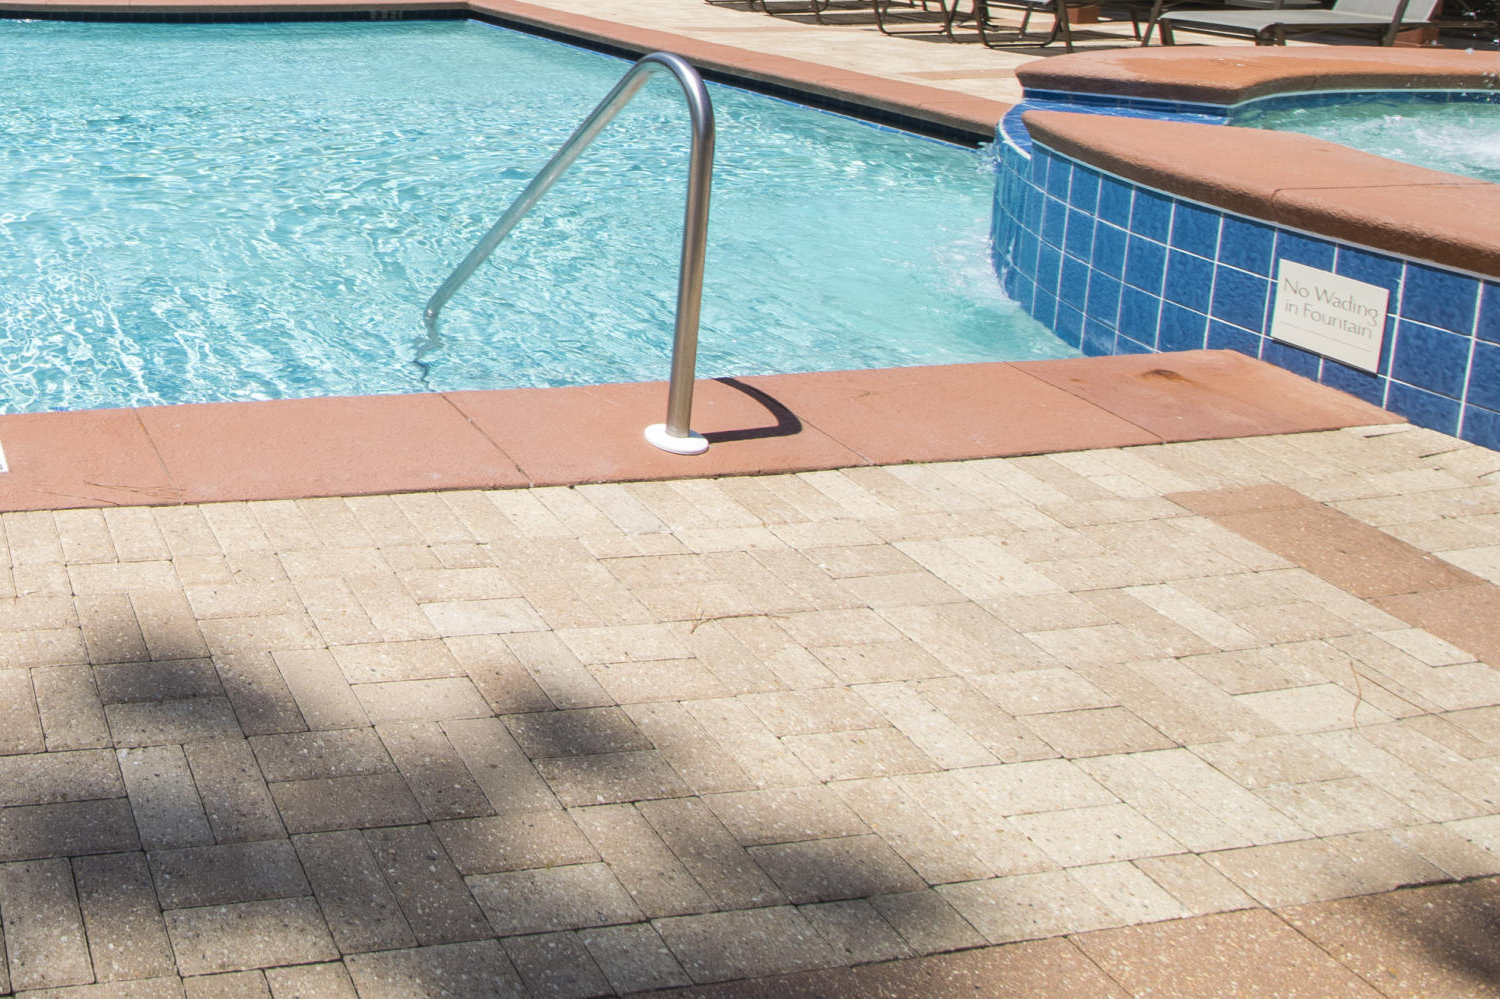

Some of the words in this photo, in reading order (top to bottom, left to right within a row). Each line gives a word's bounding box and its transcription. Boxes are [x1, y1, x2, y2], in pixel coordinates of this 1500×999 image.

[1282, 277, 1310, 299] No
[1314, 285, 1379, 328] Wading
[1284, 299, 1299, 316] in
[1303, 302, 1373, 340] Fountain
